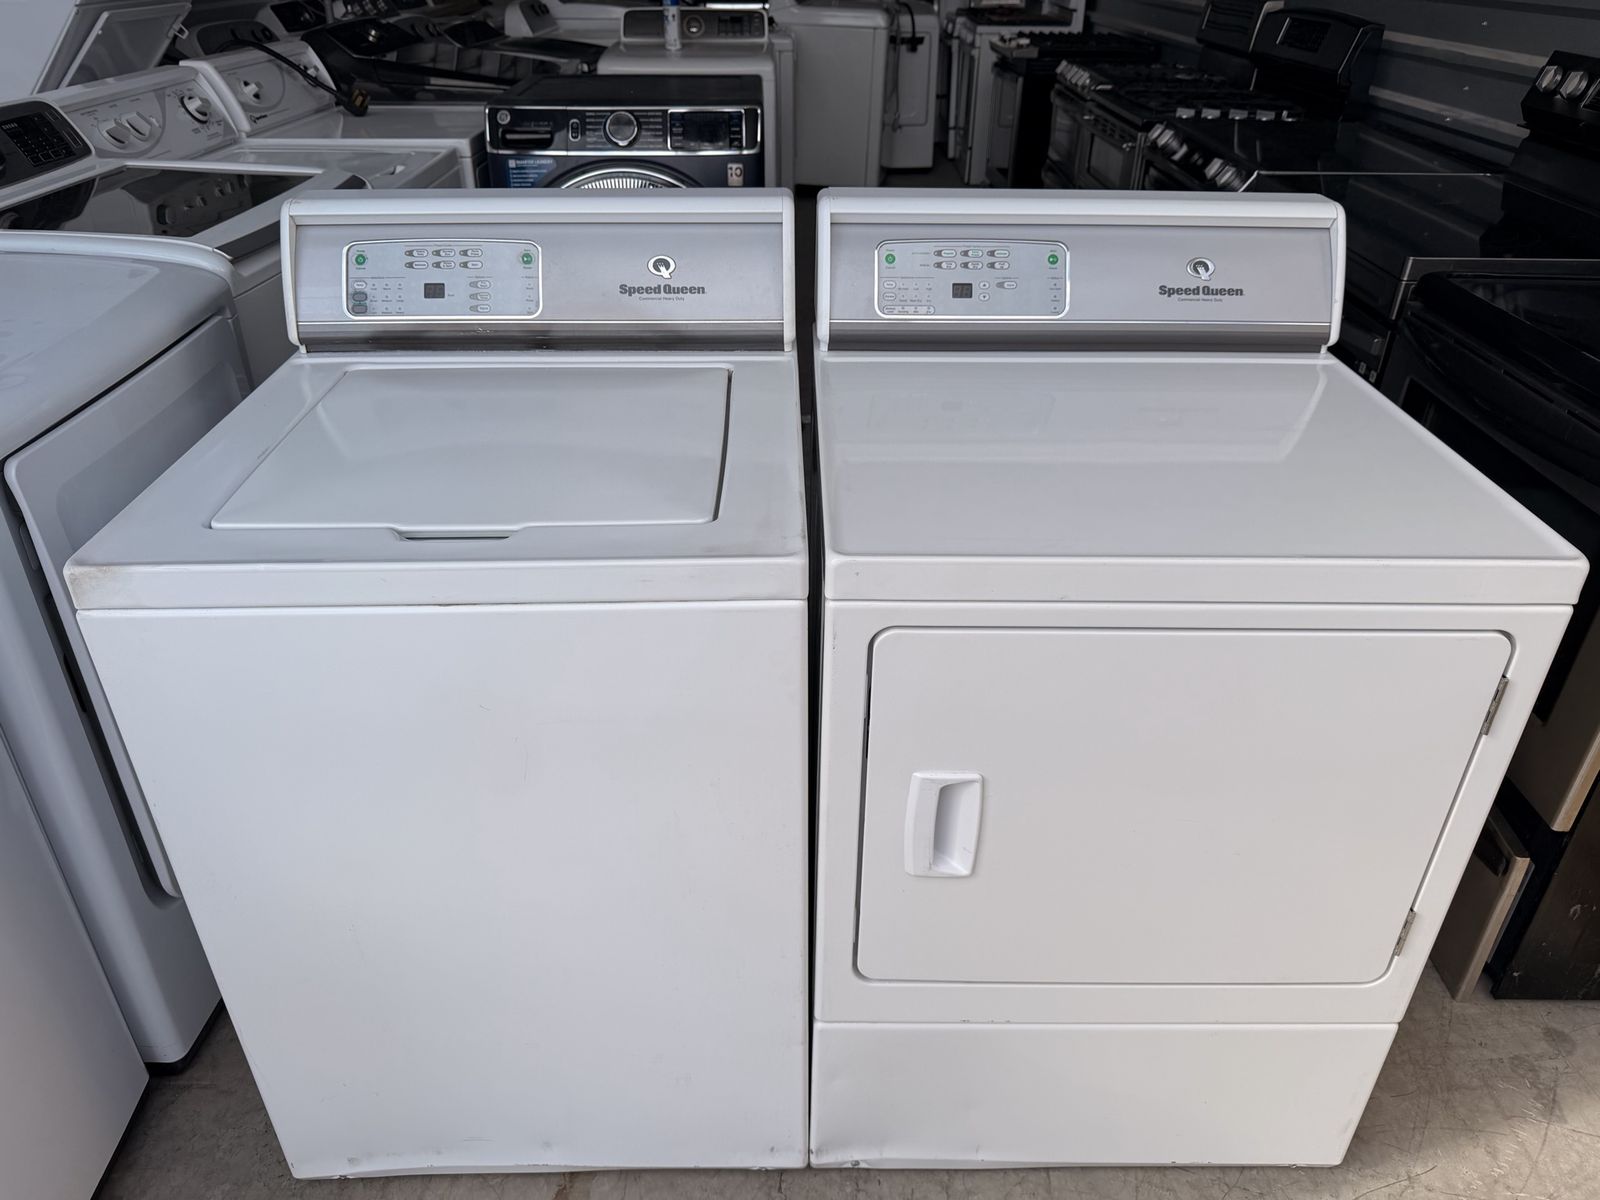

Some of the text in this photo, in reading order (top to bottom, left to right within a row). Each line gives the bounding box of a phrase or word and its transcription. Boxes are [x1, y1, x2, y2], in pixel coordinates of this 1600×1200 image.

[619, 284, 706, 297] Speed Queen
[1158, 285, 1244, 298] Speed Queen
